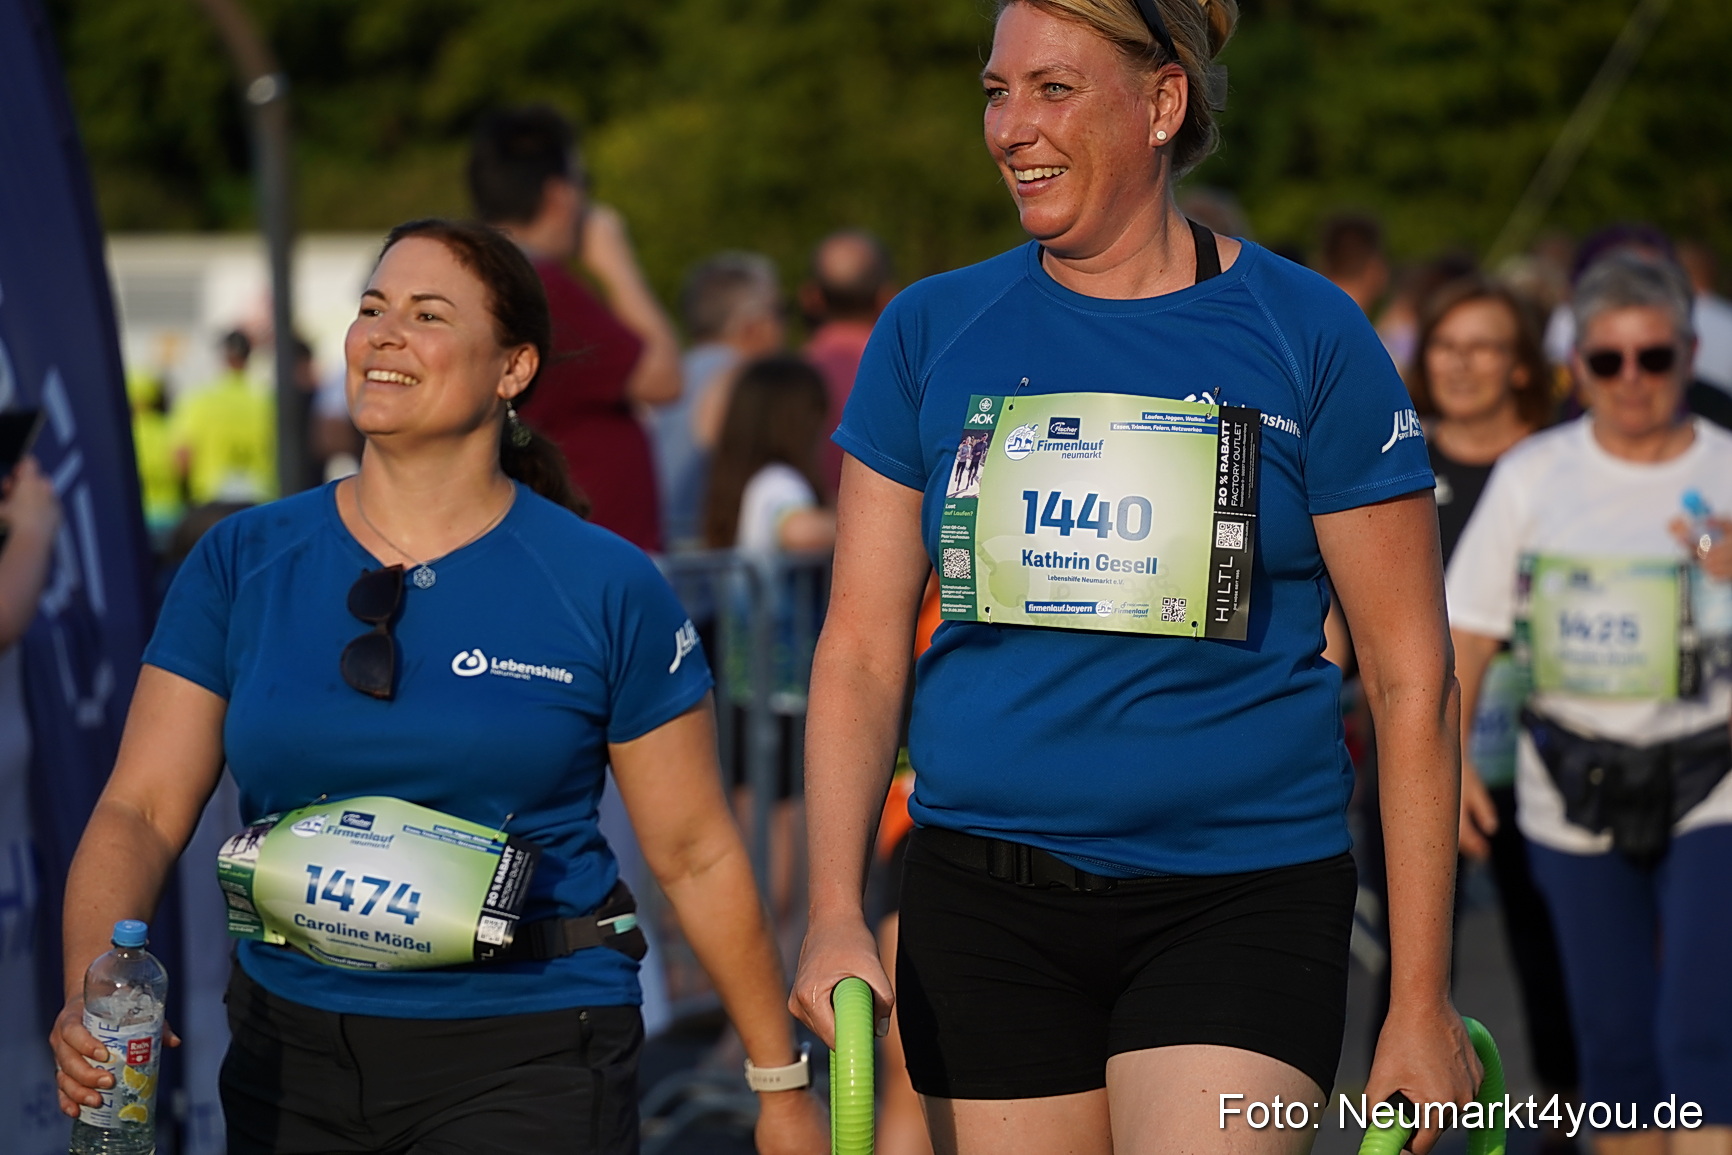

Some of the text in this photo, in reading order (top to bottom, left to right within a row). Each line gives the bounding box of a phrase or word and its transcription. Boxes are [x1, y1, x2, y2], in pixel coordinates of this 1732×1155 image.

[968, 413, 995, 425] AOK
[1145, 413, 1164, 421] Laufen,
[1153, 424, 1171, 432] Feiern,
[1171, 425, 1203, 433] Netzwerken
[1037, 439, 1105, 452] Firmenlauf
[1061, 451, 1102, 460] neumarkt
[1218, 420, 1231, 507] 20 % RABATT
[1231, 422, 1242, 507] FACTORY OUTLET
[1022, 490, 1152, 541] 1440
[1022, 549, 1158, 575] Kathrin Gesell
[1047, 574, 1081, 583] Lebenshilfe
[1082, 576, 1112, 585] Neumarkt
[1215, 556, 1234, 622] HILTL
[1028, 603, 1093, 614] firmenlauf.bayern
[491, 656, 574, 684] Lebenshilfe
[326, 825, 395, 843] Firmenlauf
[486, 891, 499, 907] 20
[495, 845, 515, 884] RABATT
[306, 864, 421, 925] 1474
[294, 913, 370, 941] Caroline
[374, 930, 432, 953] Mößel
